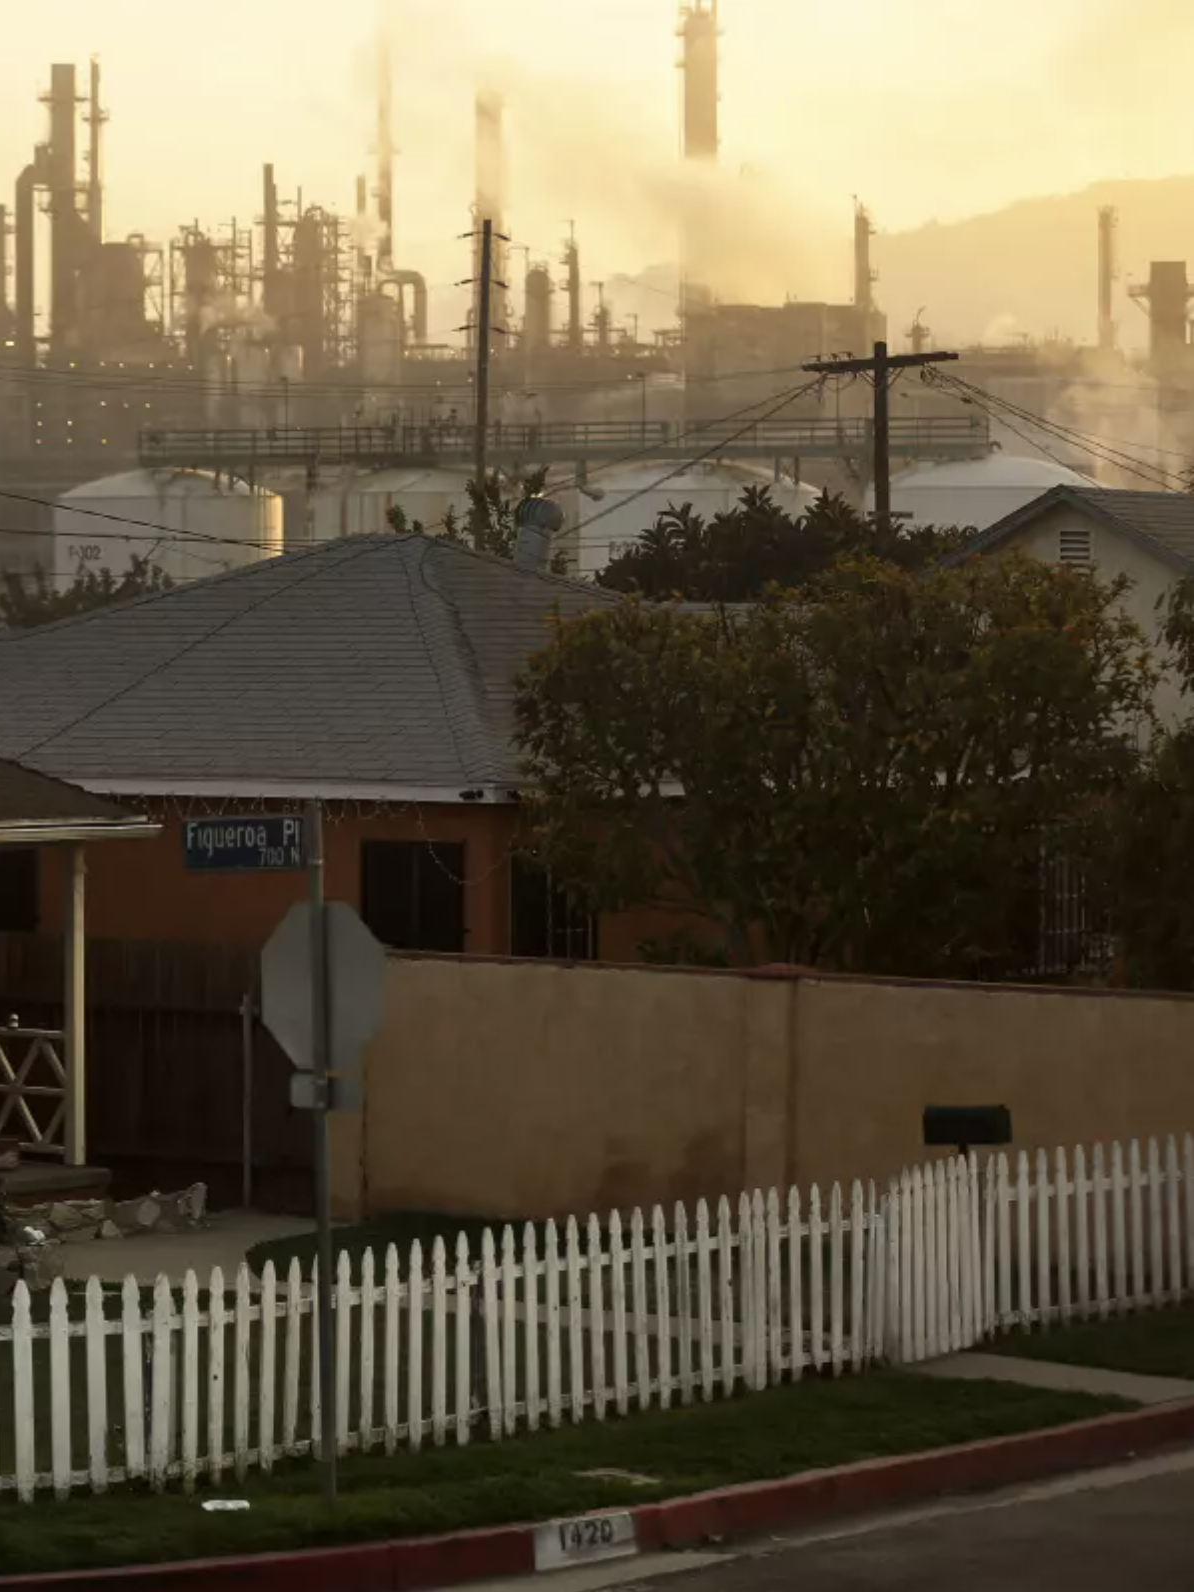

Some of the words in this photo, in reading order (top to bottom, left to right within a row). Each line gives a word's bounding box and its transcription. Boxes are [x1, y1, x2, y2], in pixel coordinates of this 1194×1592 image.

[186, 821, 267, 858] Figueroa
[283, 818, 300, 847] Pl
[258, 846, 285, 867] 700
[291, 845, 301, 867] N
[559, 1518, 613, 1551] 1420
